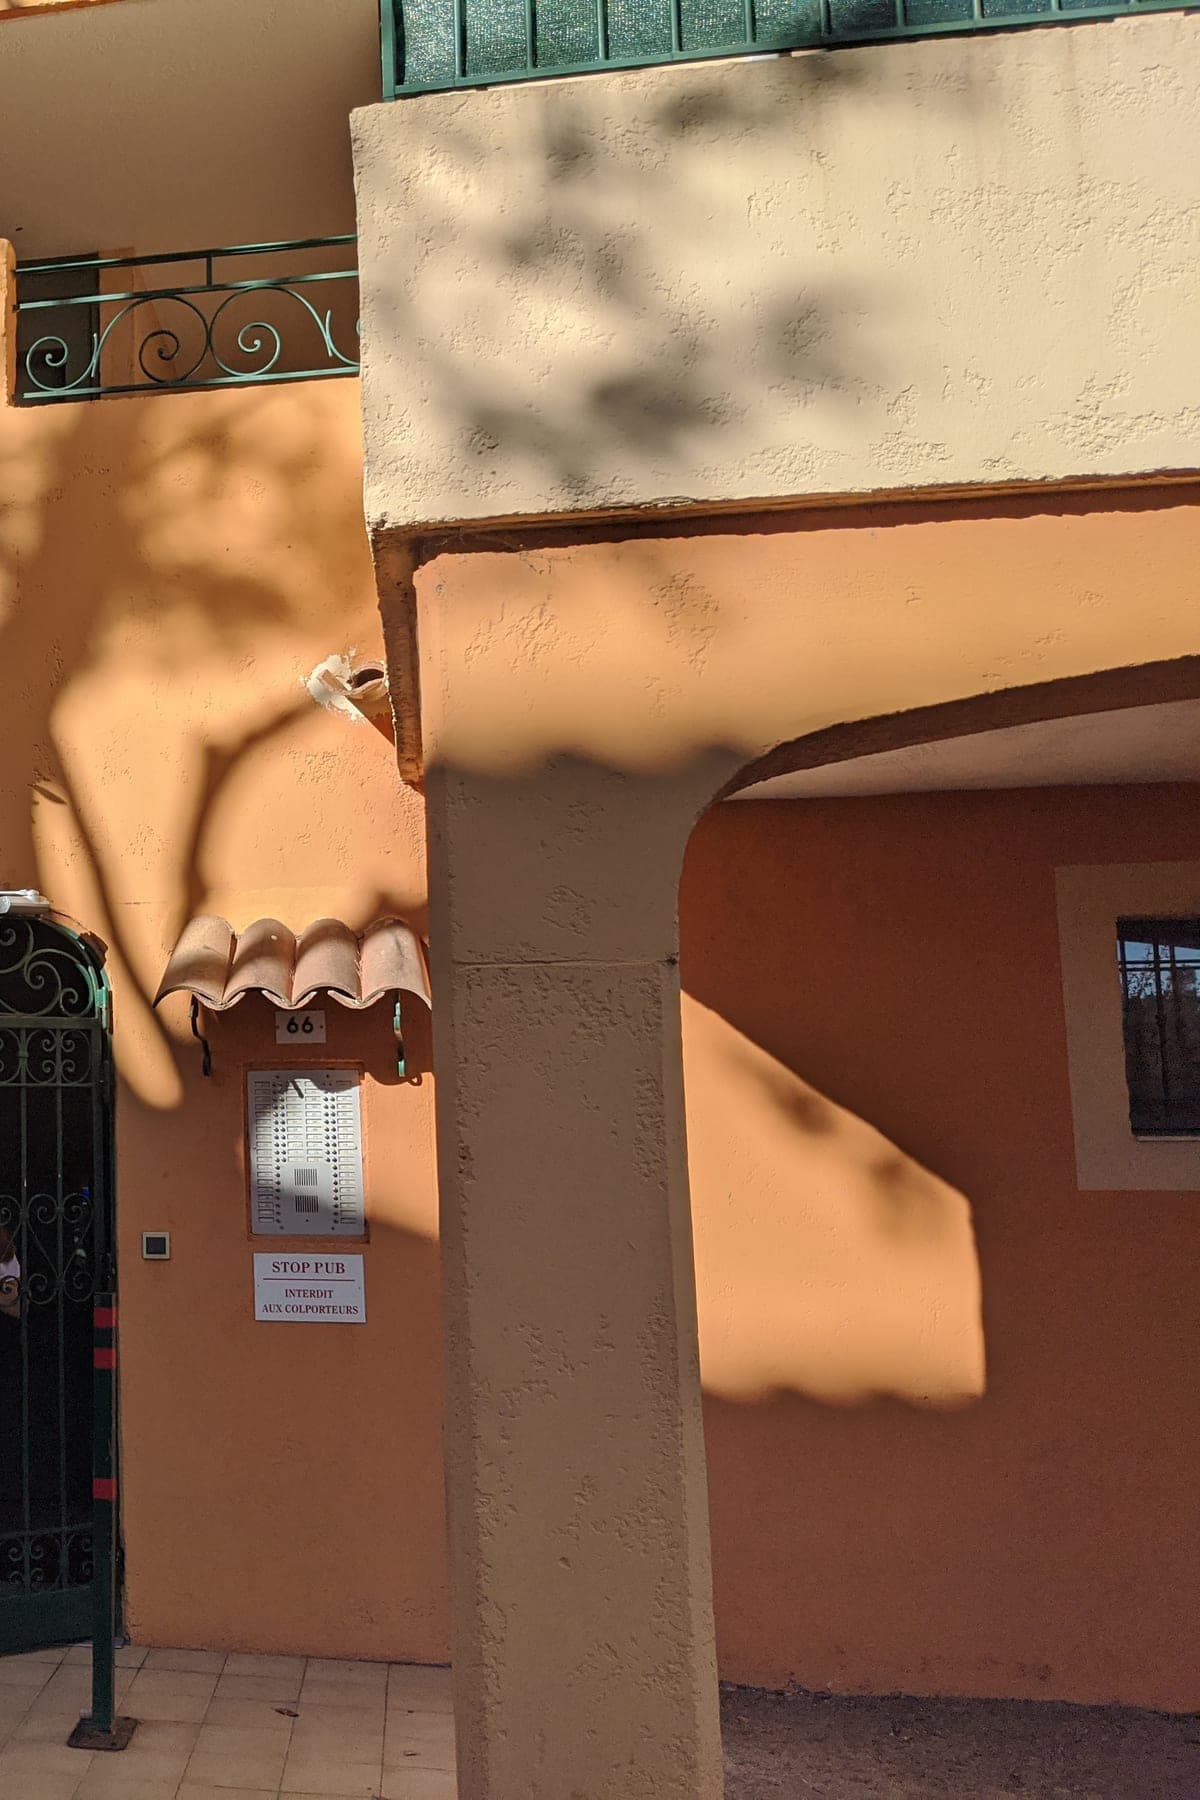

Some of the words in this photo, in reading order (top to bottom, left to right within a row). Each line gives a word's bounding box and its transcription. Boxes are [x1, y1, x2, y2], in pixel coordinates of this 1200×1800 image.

[287, 1016, 313, 1034] 66
[272, 1262, 310, 1273] STOP
[314, 1262, 346, 1274] PUB
[285, 1288, 334, 1299] INTERDIT
[262, 1304, 282, 1313] AUX
[285, 1304, 359, 1315] COLPORTEURS
